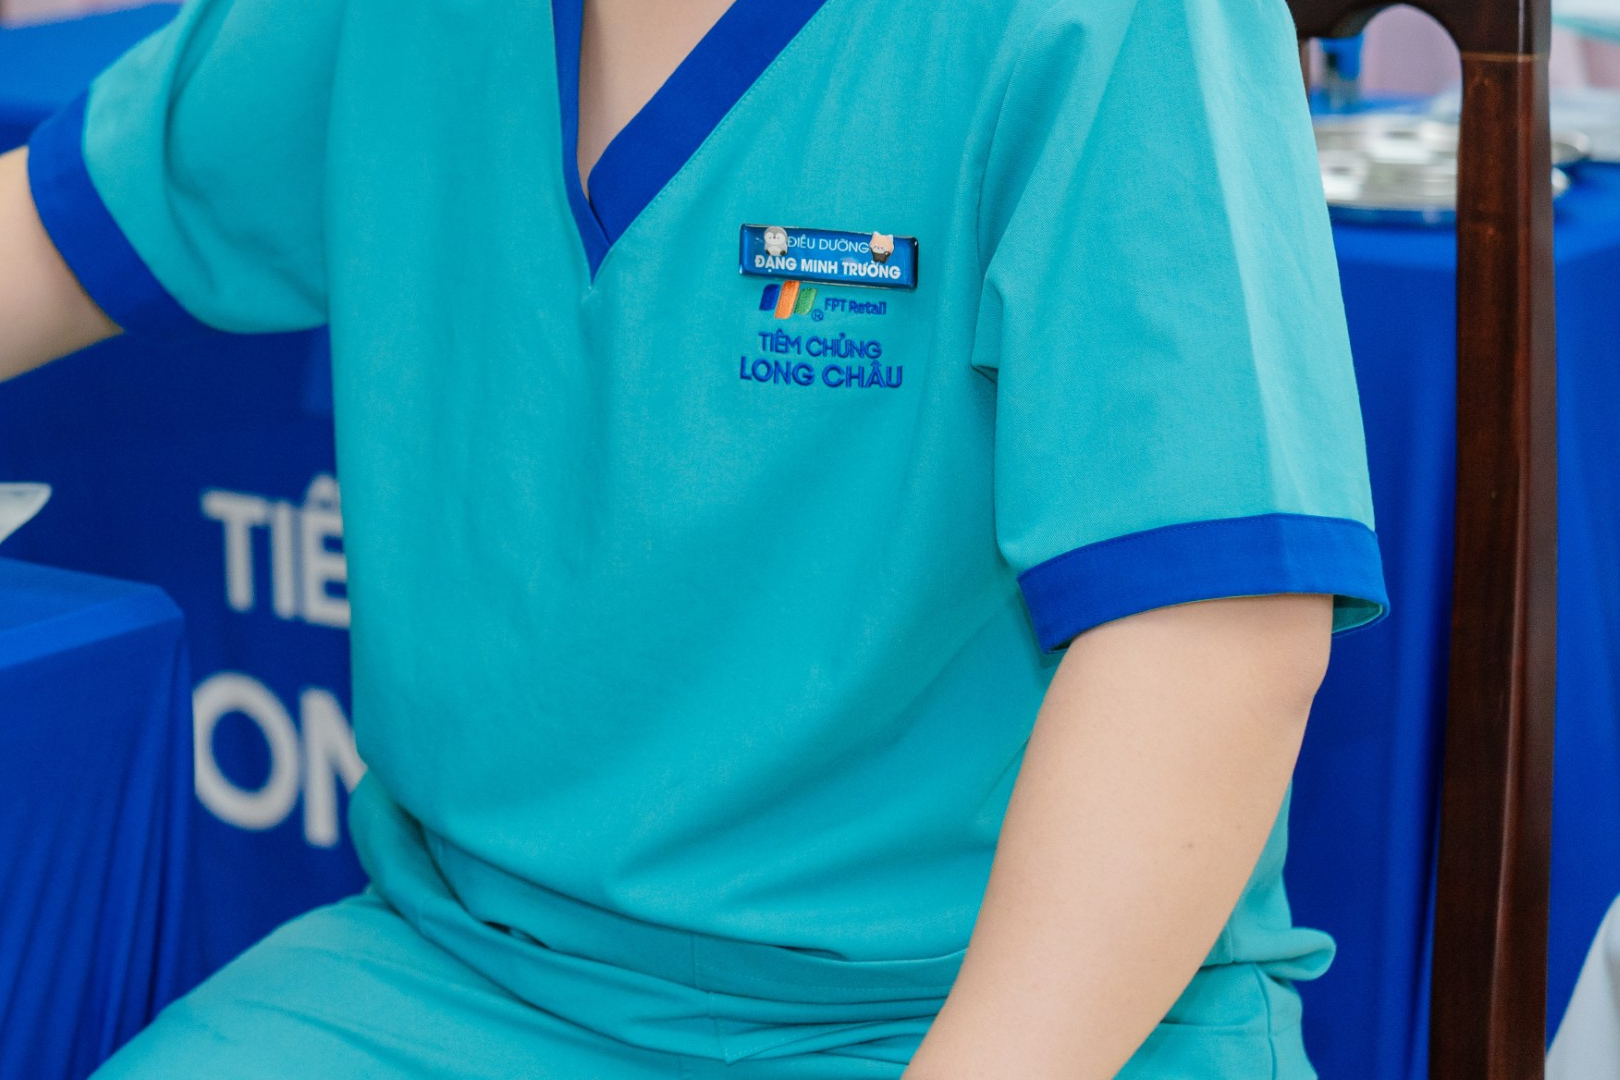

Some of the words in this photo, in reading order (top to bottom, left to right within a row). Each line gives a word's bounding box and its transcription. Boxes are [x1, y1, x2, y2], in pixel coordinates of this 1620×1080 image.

[800, 258, 838, 275] MINH
[824, 297, 847, 313] FPT
[848, 300, 887, 316] Retail
[758, 328, 802, 356] TIÊM
[740, 355, 816, 387] LONG
[822, 359, 903, 389] CHÂU
